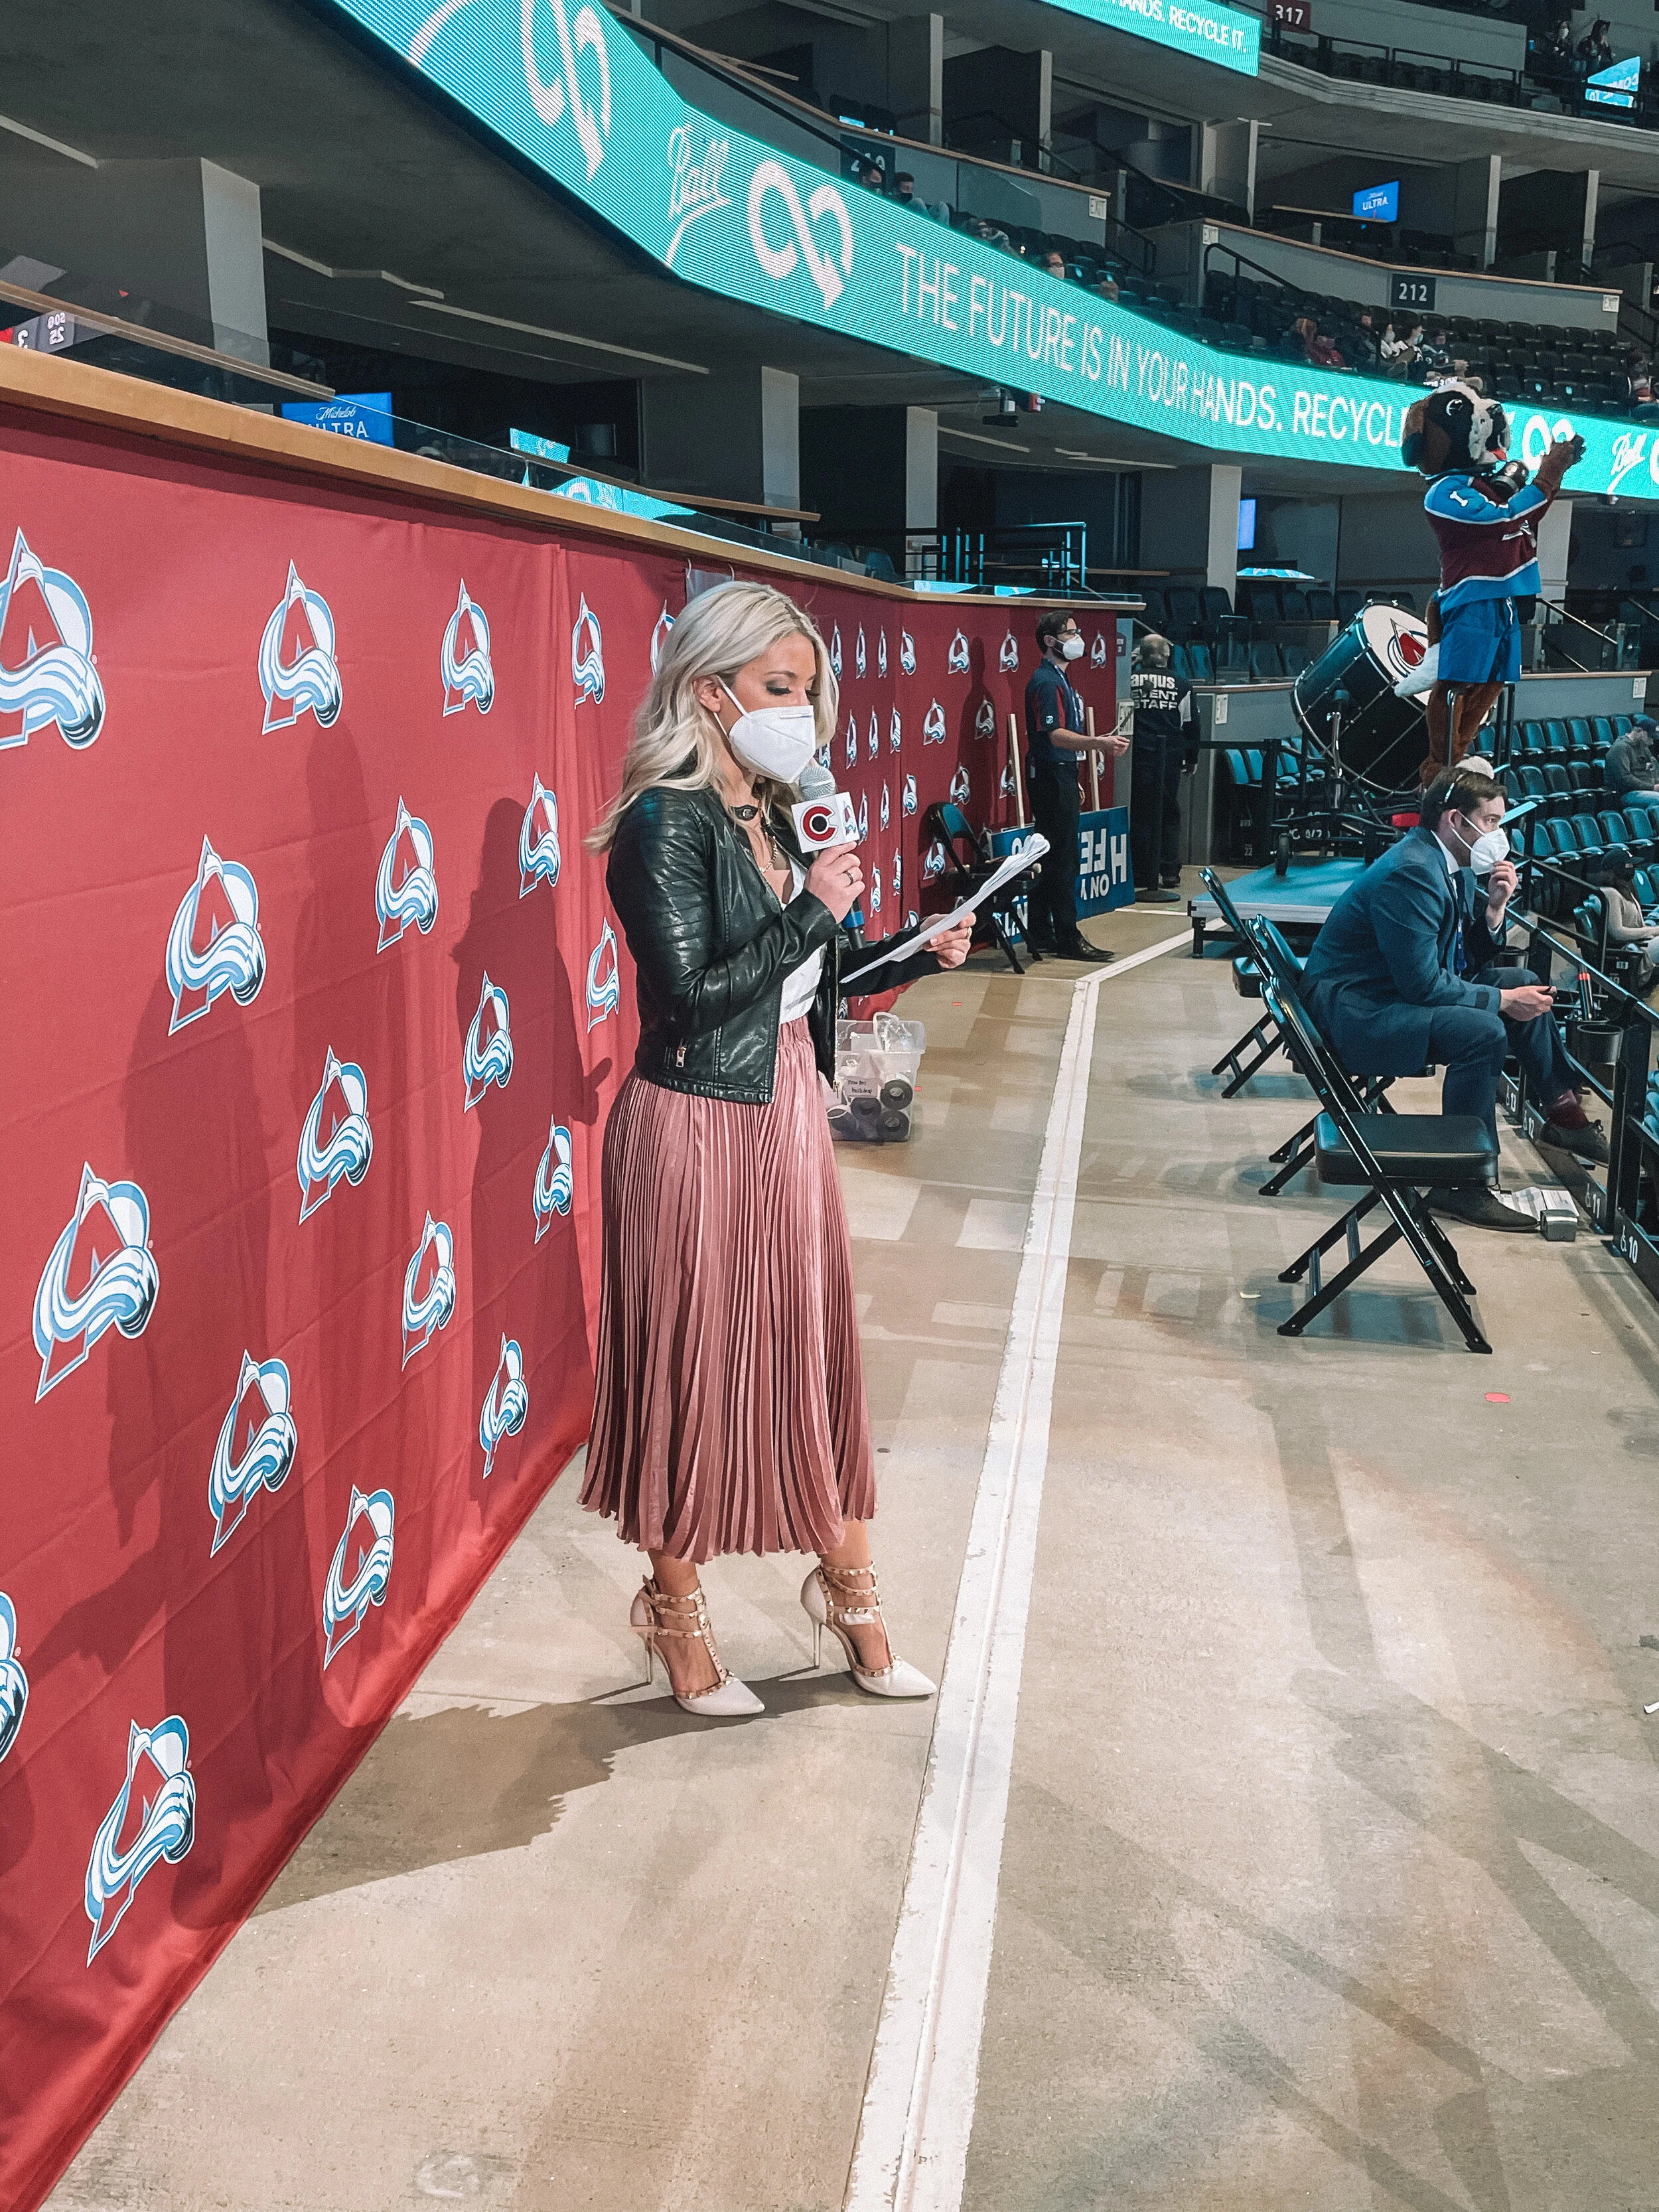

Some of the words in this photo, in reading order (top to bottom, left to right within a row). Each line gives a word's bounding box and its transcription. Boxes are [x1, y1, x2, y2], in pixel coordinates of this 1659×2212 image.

[1275, 4, 1304, 25] 317
[1169, 5, 1229, 46] RECYCLE
[1231, 29, 1247, 53] IT.
[1362, 196, 1389, 210] ULTRA
[1398, 282, 1427, 302] 212
[896, 244, 961, 332] THE
[969, 275, 1077, 372] FUTURE
[1080, 323, 1104, 382] IS
[1108, 333, 1131, 392] IN
[1137, 344, 1189, 410] YOUR
[1191, 367, 1282, 432] HANDS.
[315, 406, 357, 421] Michelob
[308, 421, 370, 438] TRA
[1131, 689, 1179, 701] EVENT
[1132, 698, 1178, 711] STAFF
[1592, 1193, 1601, 1219] 11
[1628, 1236, 1638, 1264] 10
